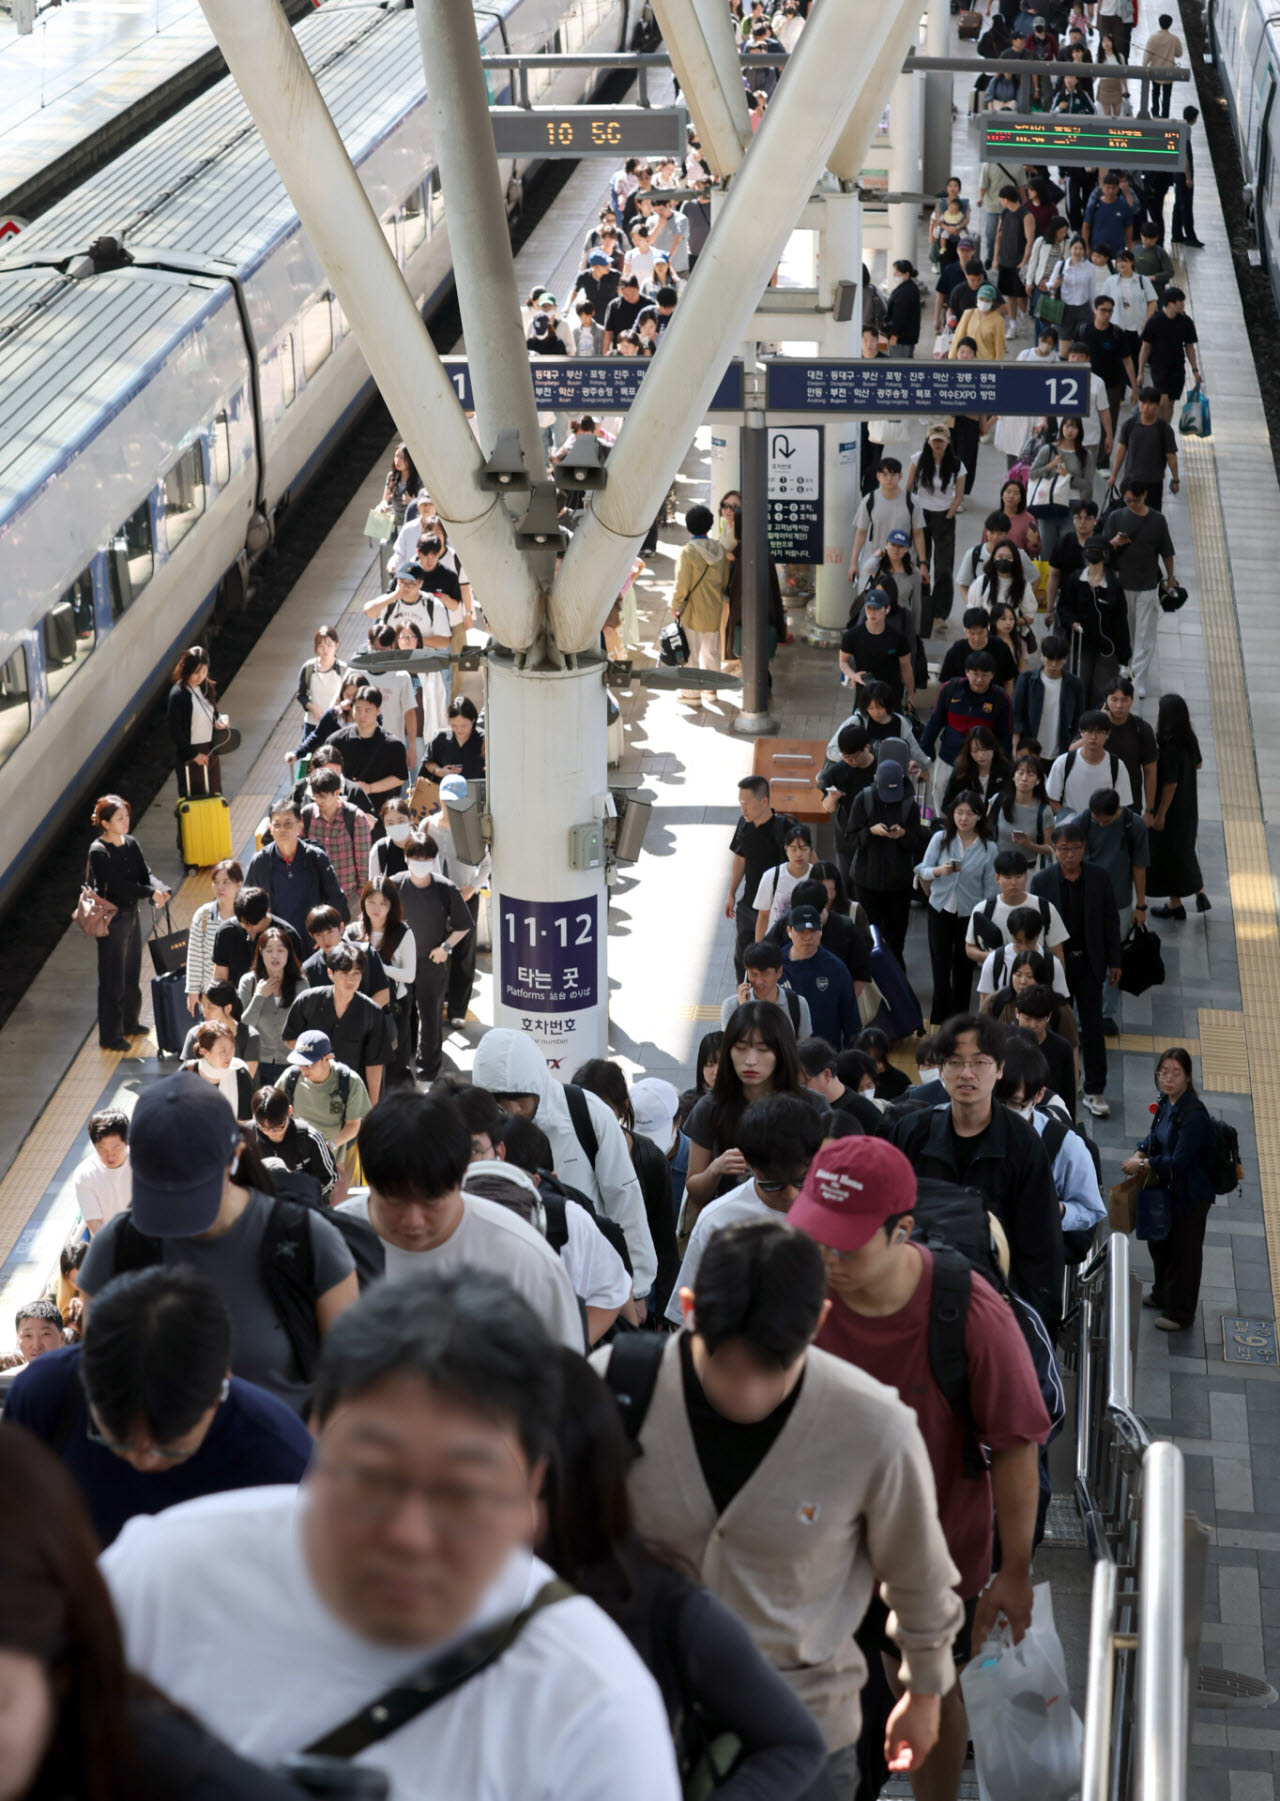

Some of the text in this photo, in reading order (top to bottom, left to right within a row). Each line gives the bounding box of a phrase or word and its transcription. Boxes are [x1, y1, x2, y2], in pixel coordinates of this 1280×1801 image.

[547, 122, 573, 144] 10
[535, 370, 559, 380] 동대구
[566, 370, 582, 380] 부산
[590, 370, 606, 380] 포항
[614, 370, 630, 380] 진주
[807, 370, 996, 383] 대전 동대구 부산 포항 진주 마산 강릉 동해
[536, 387, 636, 397] 부전 익산 광주송정 목포
[807, 387, 996, 400] 안동 부전 익산 광주송정 목포 여수EXPO 방면
[1045, 378, 1078, 404] 12
[518, 966, 579, 990] 타는 곳
[506, 984, 545, 1000] Platforms
[570, 986, 591, 999] のりば
[521, 1018, 576, 1036] 호차번호
